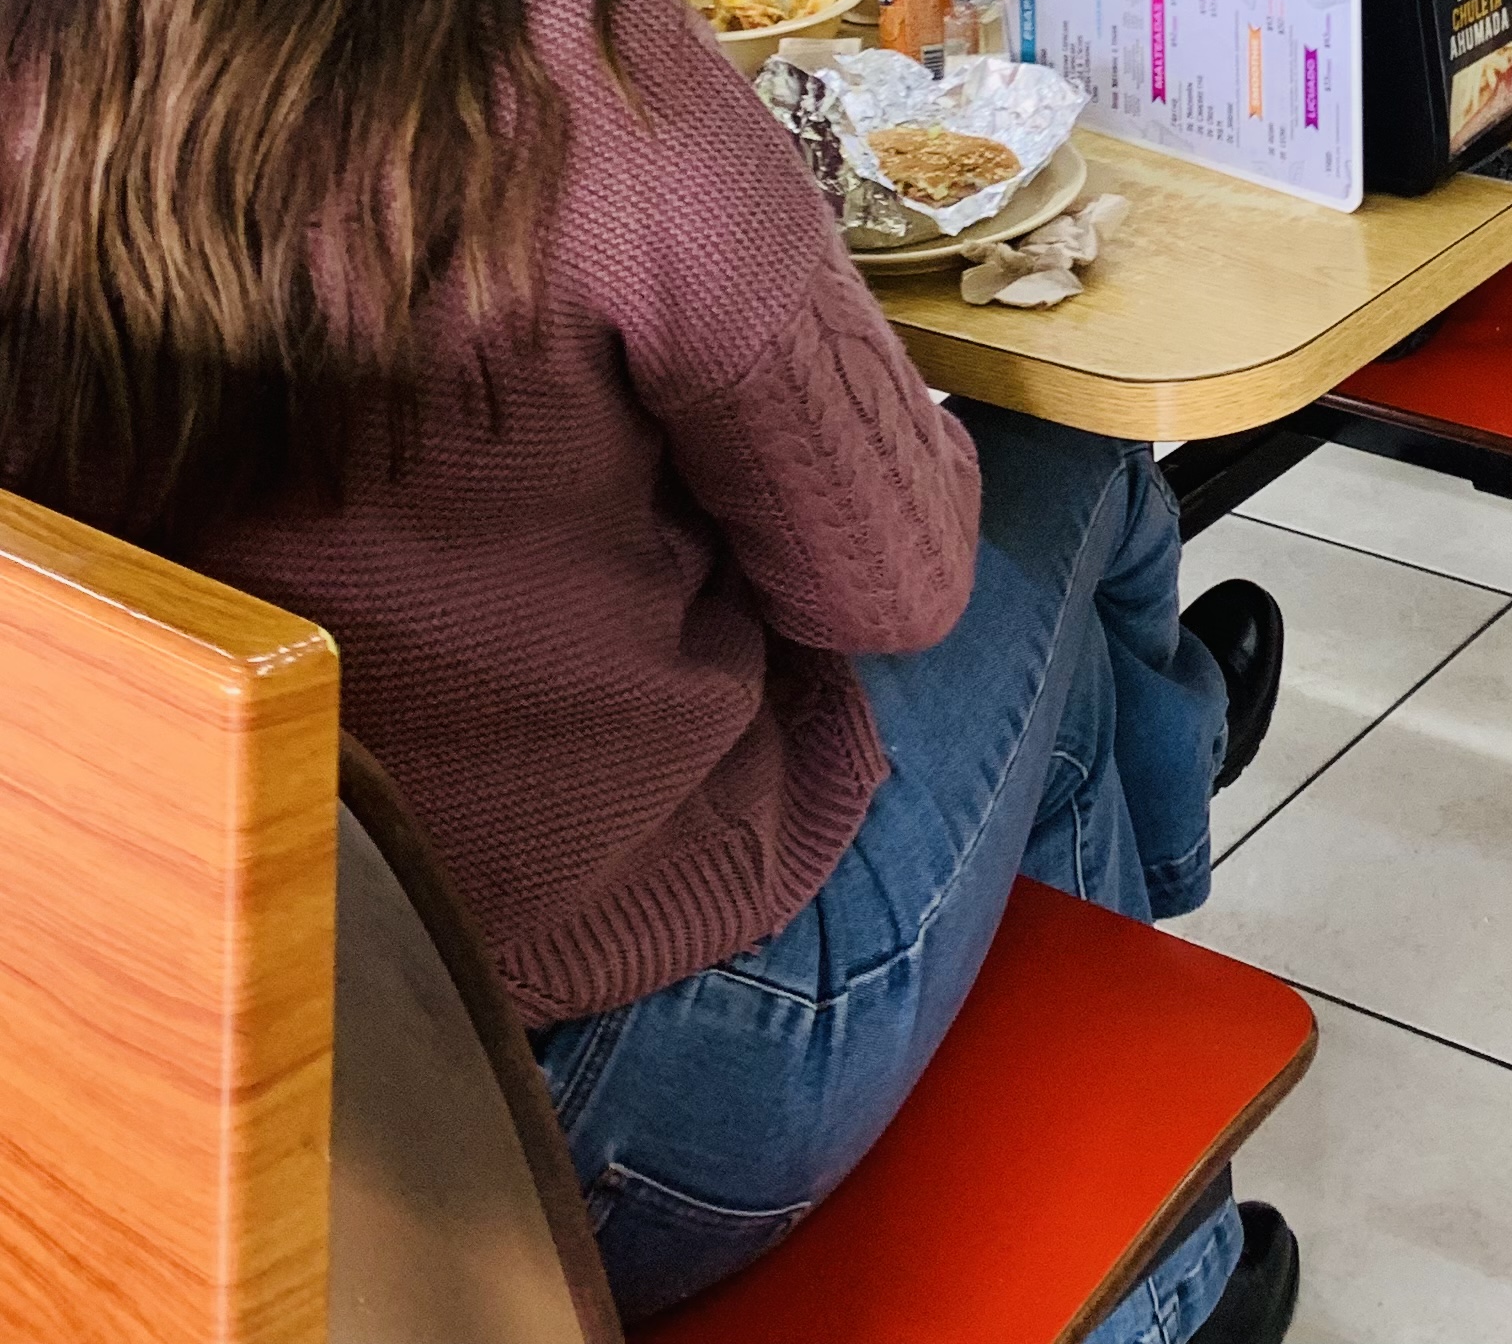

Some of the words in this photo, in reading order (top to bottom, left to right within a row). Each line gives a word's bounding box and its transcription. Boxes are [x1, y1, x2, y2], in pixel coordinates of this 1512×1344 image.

[1153, 3, 1163, 90] MALTEADAS
[1449, 6, 1511, 62] AHUMADA
[1250, 39, 1260, 107] SMOOTHIE
[1306, 58, 1316, 119] LICUADO
